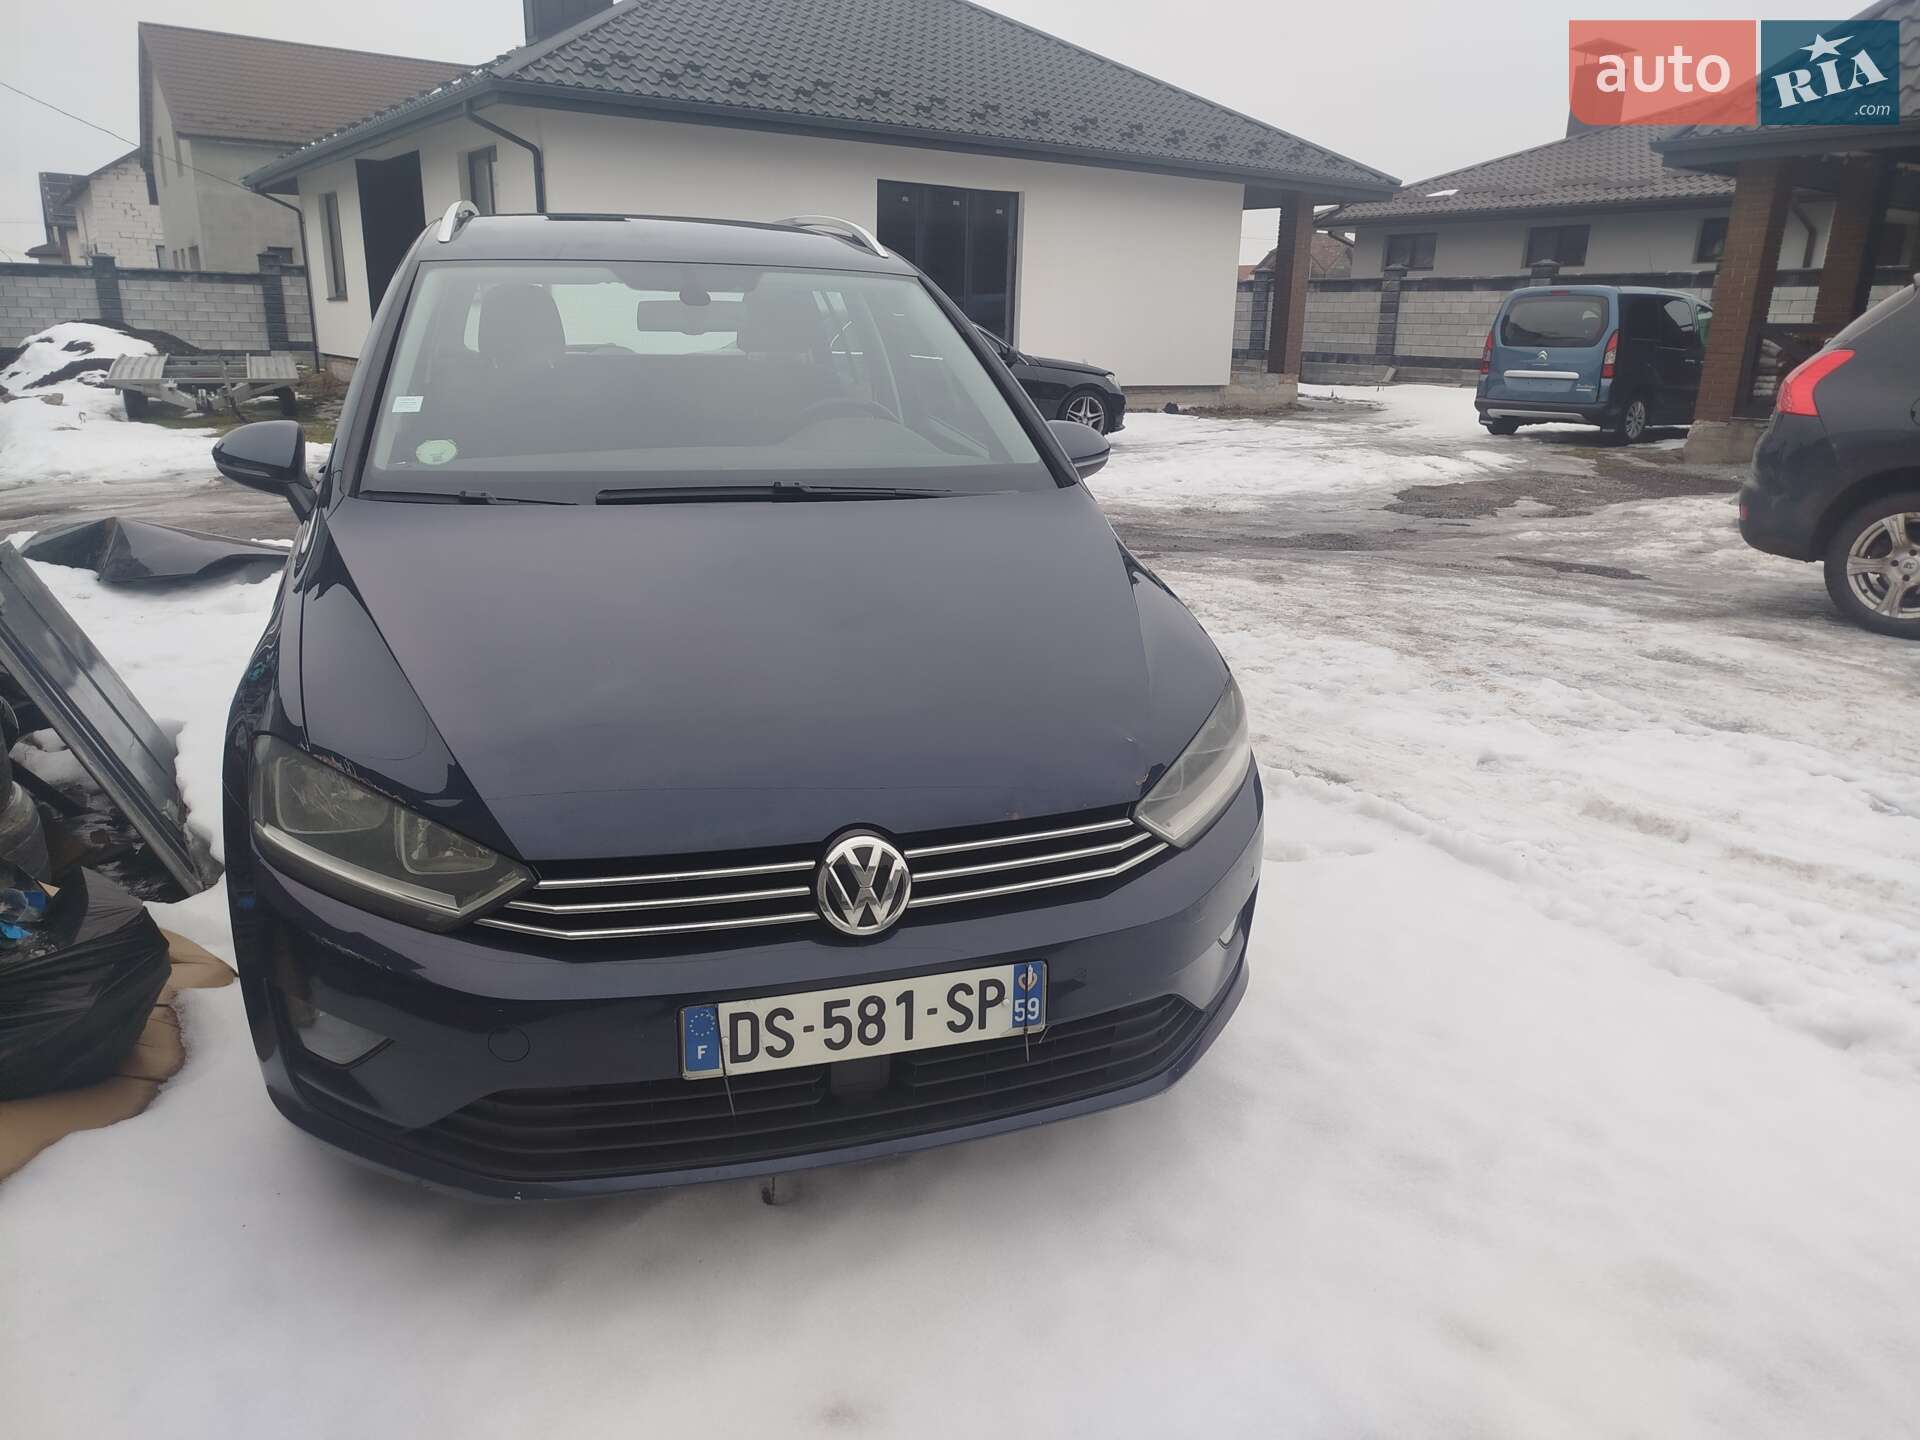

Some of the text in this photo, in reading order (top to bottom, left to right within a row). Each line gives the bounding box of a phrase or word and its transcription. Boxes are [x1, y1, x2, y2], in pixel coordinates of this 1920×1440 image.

[728, 978, 1006, 1065] DS-581-SP
[1014, 997, 1040, 1022] 59
[696, 1045, 708, 1060] F
